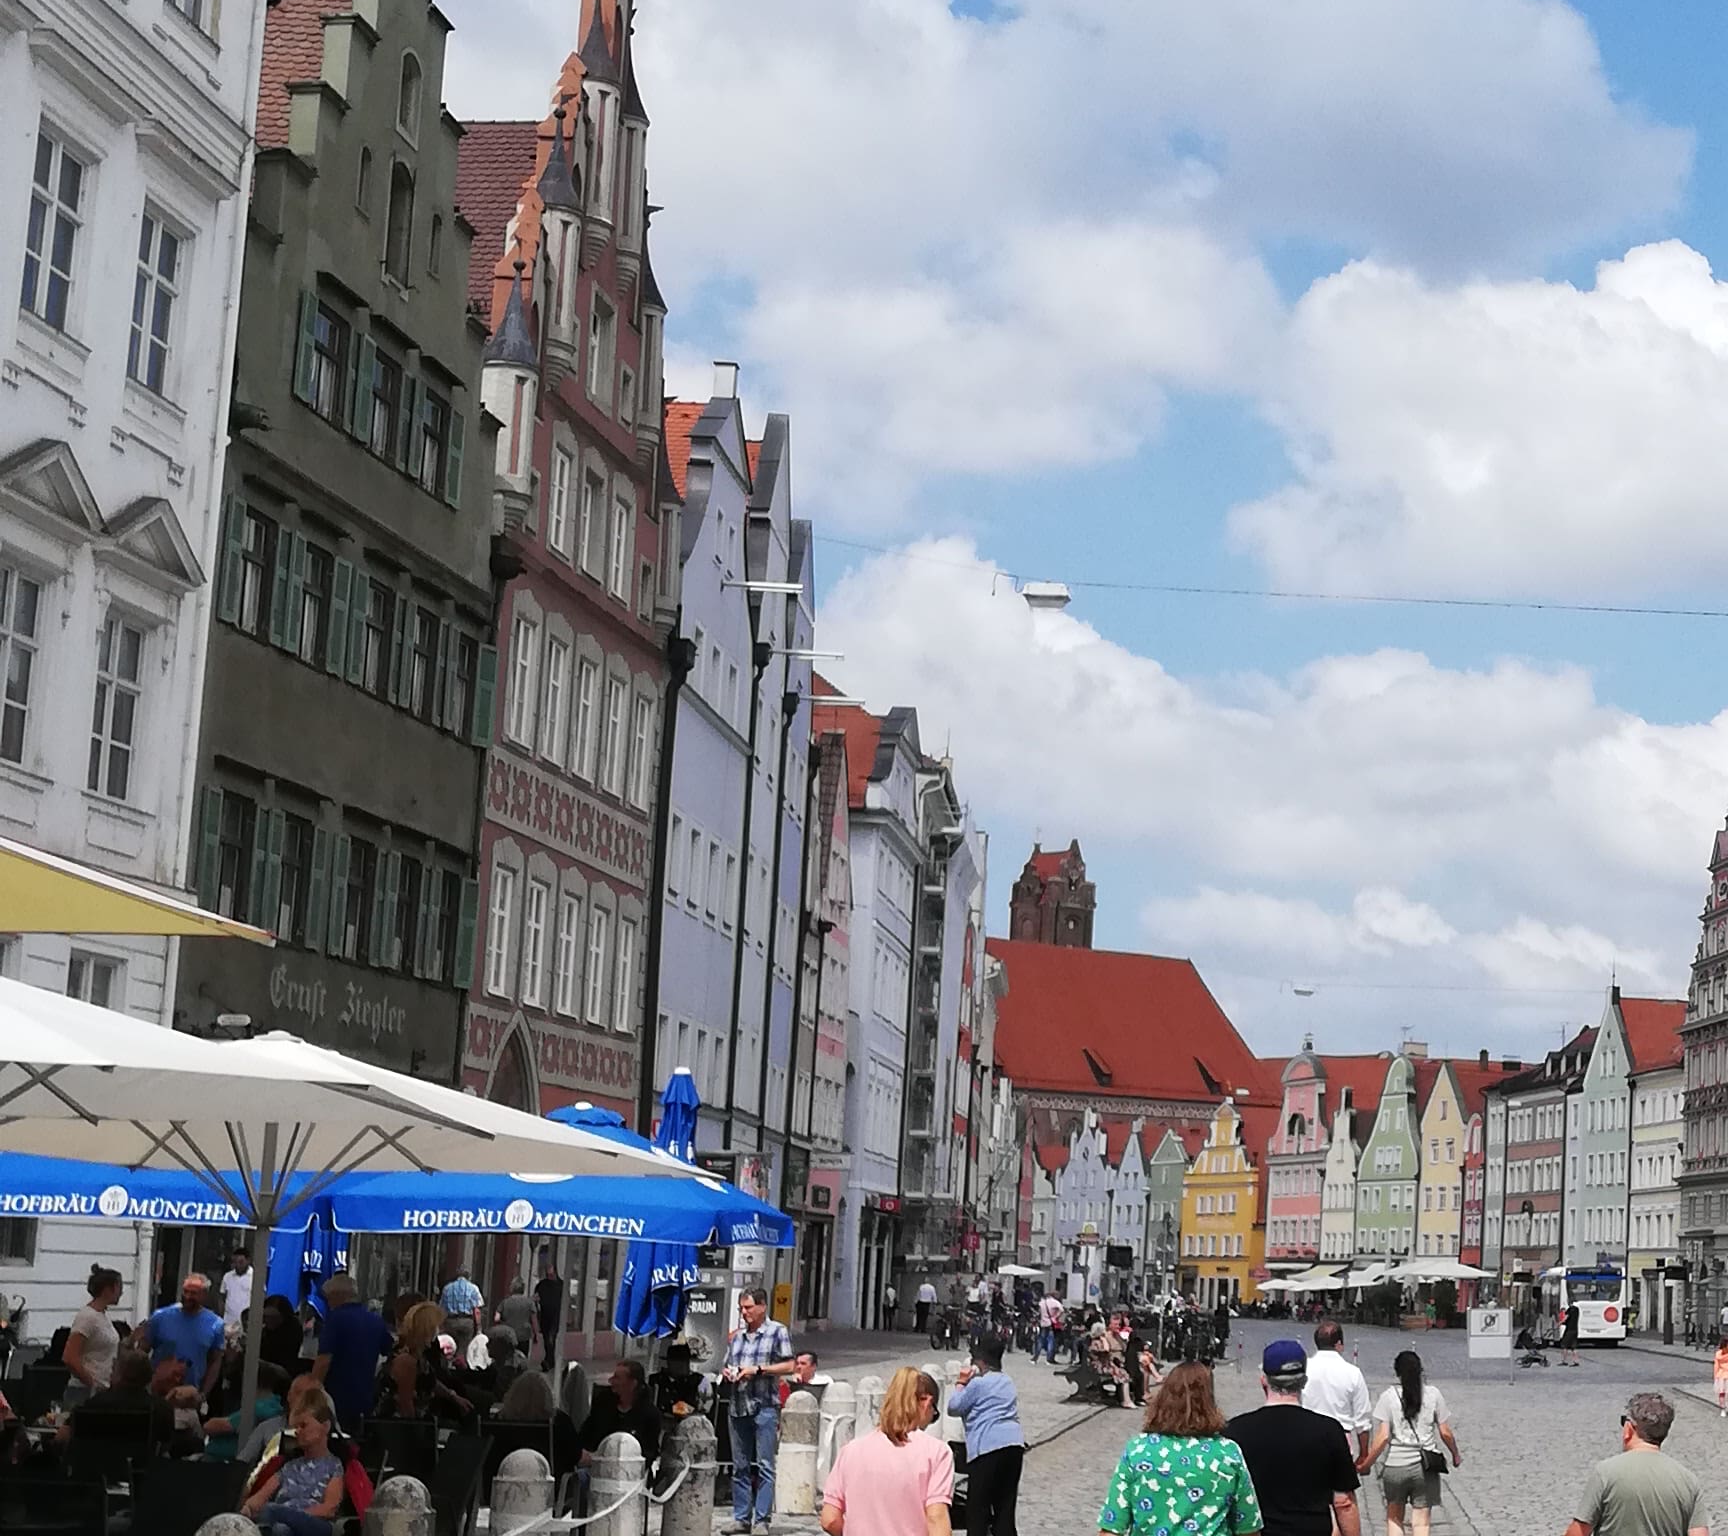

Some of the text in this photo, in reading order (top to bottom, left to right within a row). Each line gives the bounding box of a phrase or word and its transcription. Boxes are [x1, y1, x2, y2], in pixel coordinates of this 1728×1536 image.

[338, 980, 406, 1044] Ziegler
[0, 1191, 97, 1214] HOFBRÄU
[128, 1197, 241, 1223] MÜNCHEN
[403, 1207, 504, 1229] HOFBRÄU
[533, 1211, 646, 1237] MÜNCHEN
